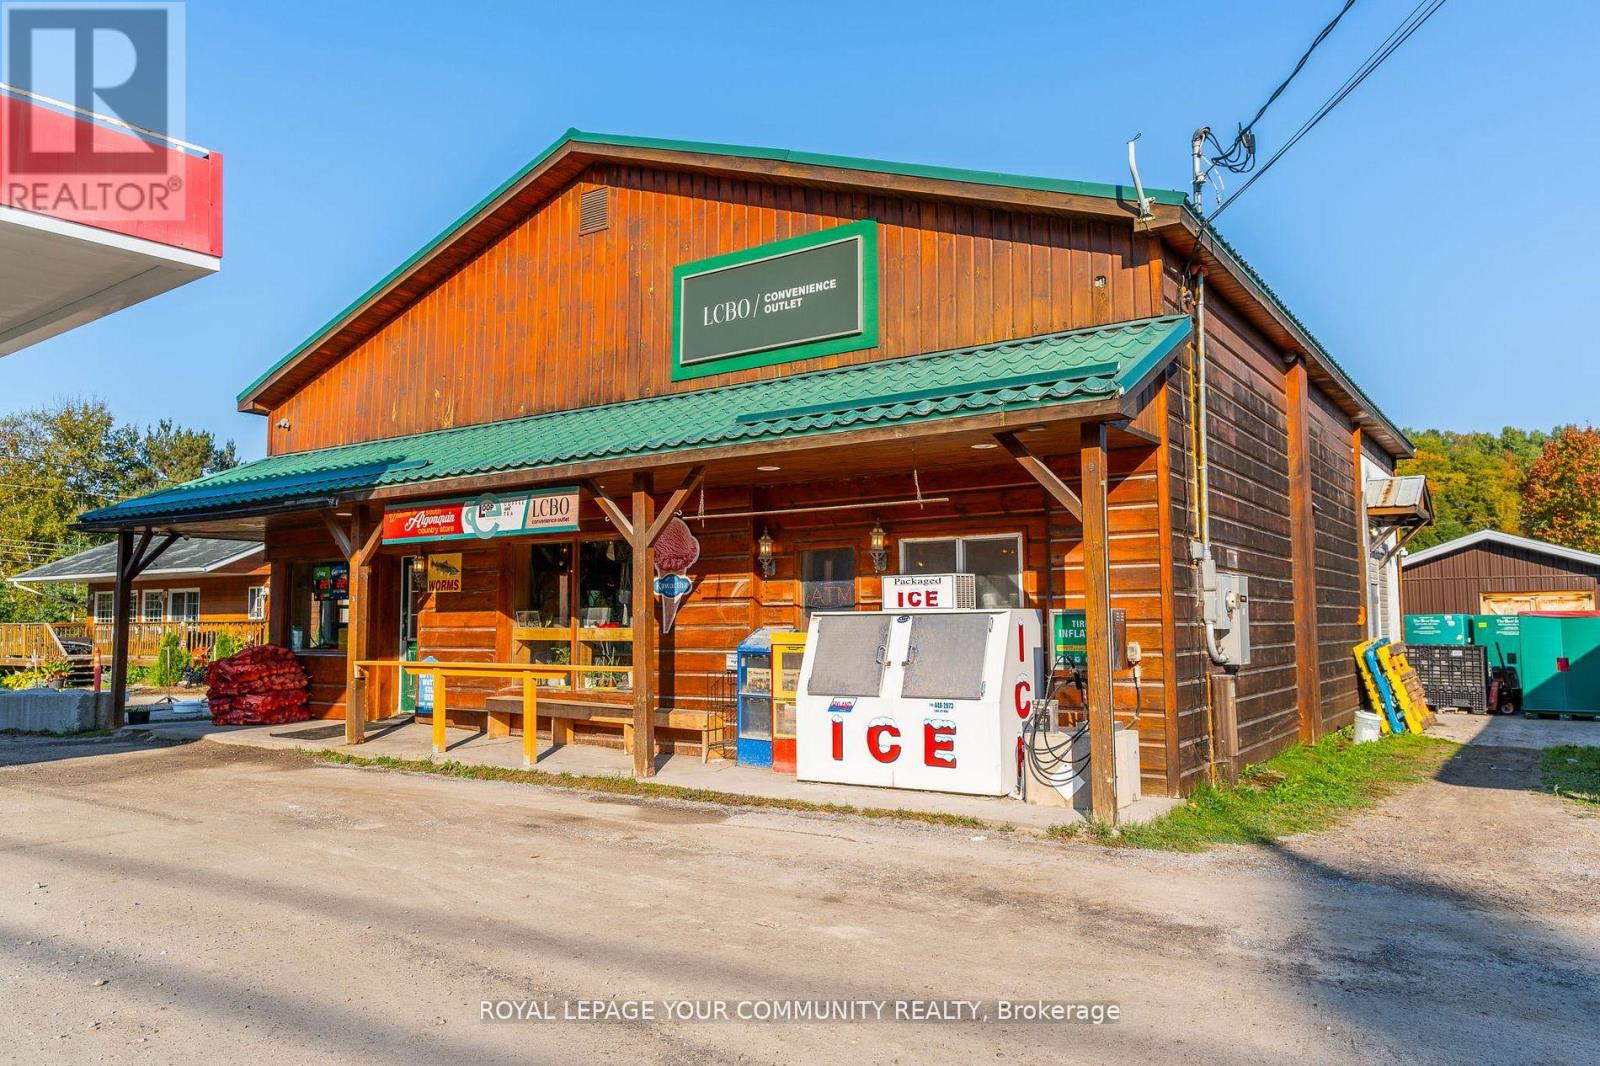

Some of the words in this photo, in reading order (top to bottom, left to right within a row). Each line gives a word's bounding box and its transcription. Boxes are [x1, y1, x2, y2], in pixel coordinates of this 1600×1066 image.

[764, 278, 837, 302] CONVENIENCE
[703, 298, 750, 326] LCBO
[764, 298, 803, 314] OUTLET
[532, 496, 570, 518] LCBO
[404, 510, 455, 531] Algonquin
[417, 526, 438, 534] country
[428, 578, 460, 592] WORMS
[894, 577, 942, 586] Packaged
[811, 586, 851, 602] ATM
[898, 590, 938, 608] ICE
[1072, 620, 1087, 628] TIR
[1058, 628, 1087, 638] INFLA
[832, 715, 957, 768] ICE
